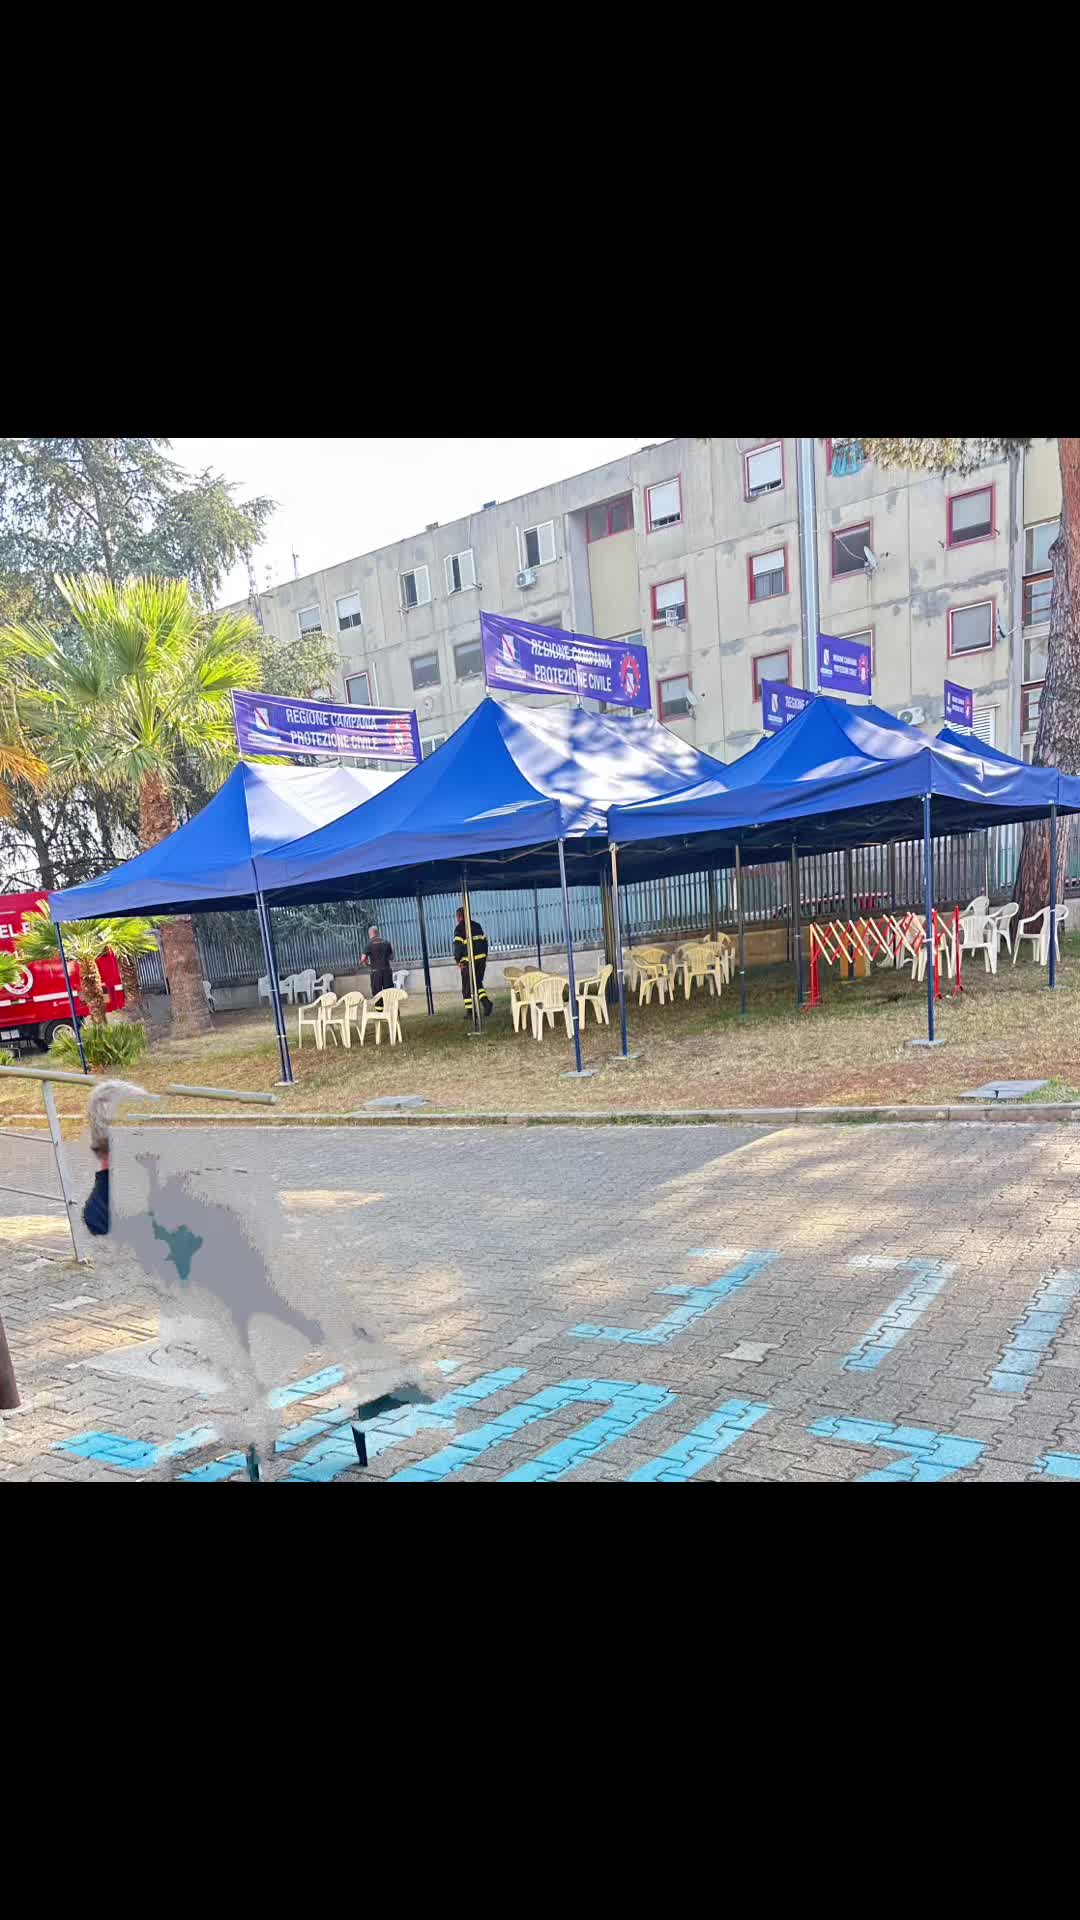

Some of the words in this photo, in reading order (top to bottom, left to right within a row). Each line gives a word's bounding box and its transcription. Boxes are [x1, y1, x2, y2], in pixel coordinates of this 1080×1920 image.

[531, 639, 570, 661] REGIONE
[570, 646, 612, 669] CAMPANIA
[534, 663, 588, 689] PROTEZIONE
[588, 673, 613, 692] CIVILE
[285, 708, 330, 726] REGIONE
[330, 713, 378, 730] CAMPANIA
[290, 730, 351, 749] PROTEZIONE
[351, 737, 379, 750] CIVILE
